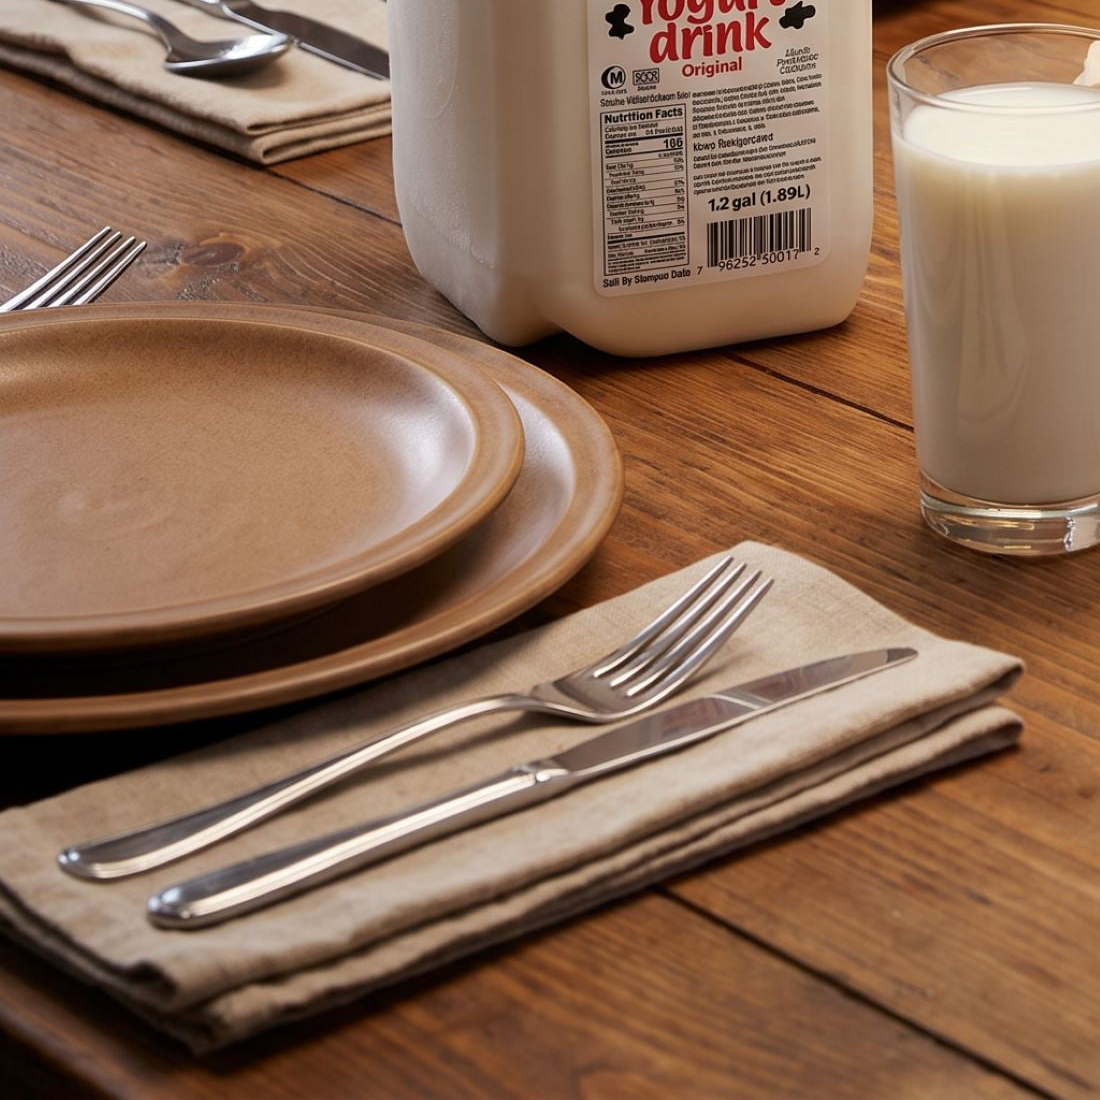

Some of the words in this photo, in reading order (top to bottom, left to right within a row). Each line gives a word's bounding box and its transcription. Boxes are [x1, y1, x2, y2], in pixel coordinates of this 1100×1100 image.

[649, 11, 773, 64] drink
[610, 71, 623, 85] M
[681, 57, 743, 79] Original
[655, 107, 683, 119] Facts
[732, 192, 756, 212] gal
[760, 183, 811, 207] (1.89L)
[697, 266, 703, 275] 7
[718, 255, 757, 272] 96252
[761, 248, 799, 265] 50017
[814, 247, 820, 256] 2
[622, 276, 633, 287] By
